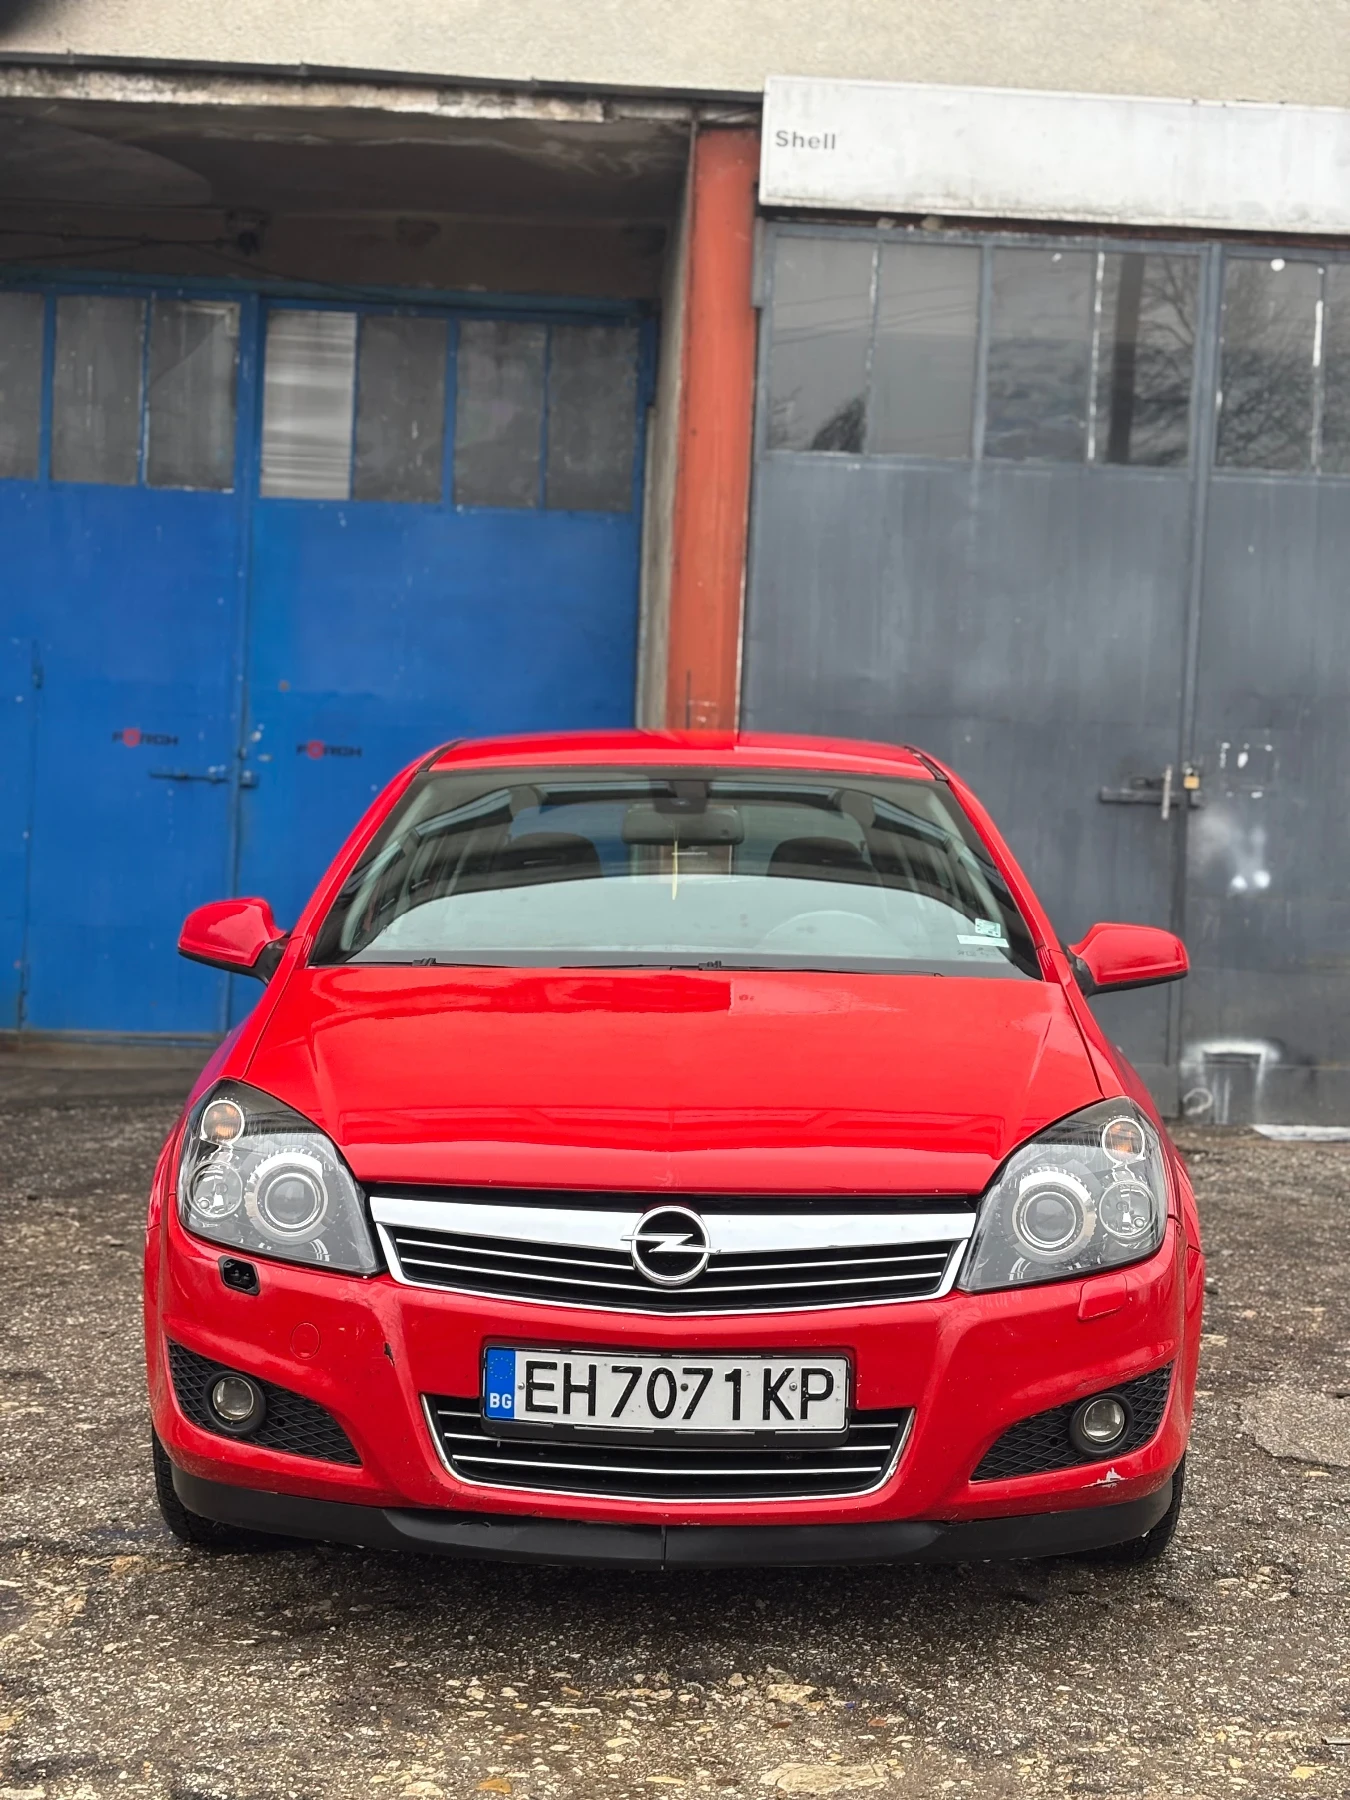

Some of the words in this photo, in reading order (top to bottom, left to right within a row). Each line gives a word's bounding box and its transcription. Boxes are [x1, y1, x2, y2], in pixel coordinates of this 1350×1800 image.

[775, 129, 836, 150] Shell
[489, 1392, 513, 1409] BG
[525, 1360, 598, 1417] EH
[610, 1364, 743, 1421] 7071
[762, 1367, 835, 1421] KP
